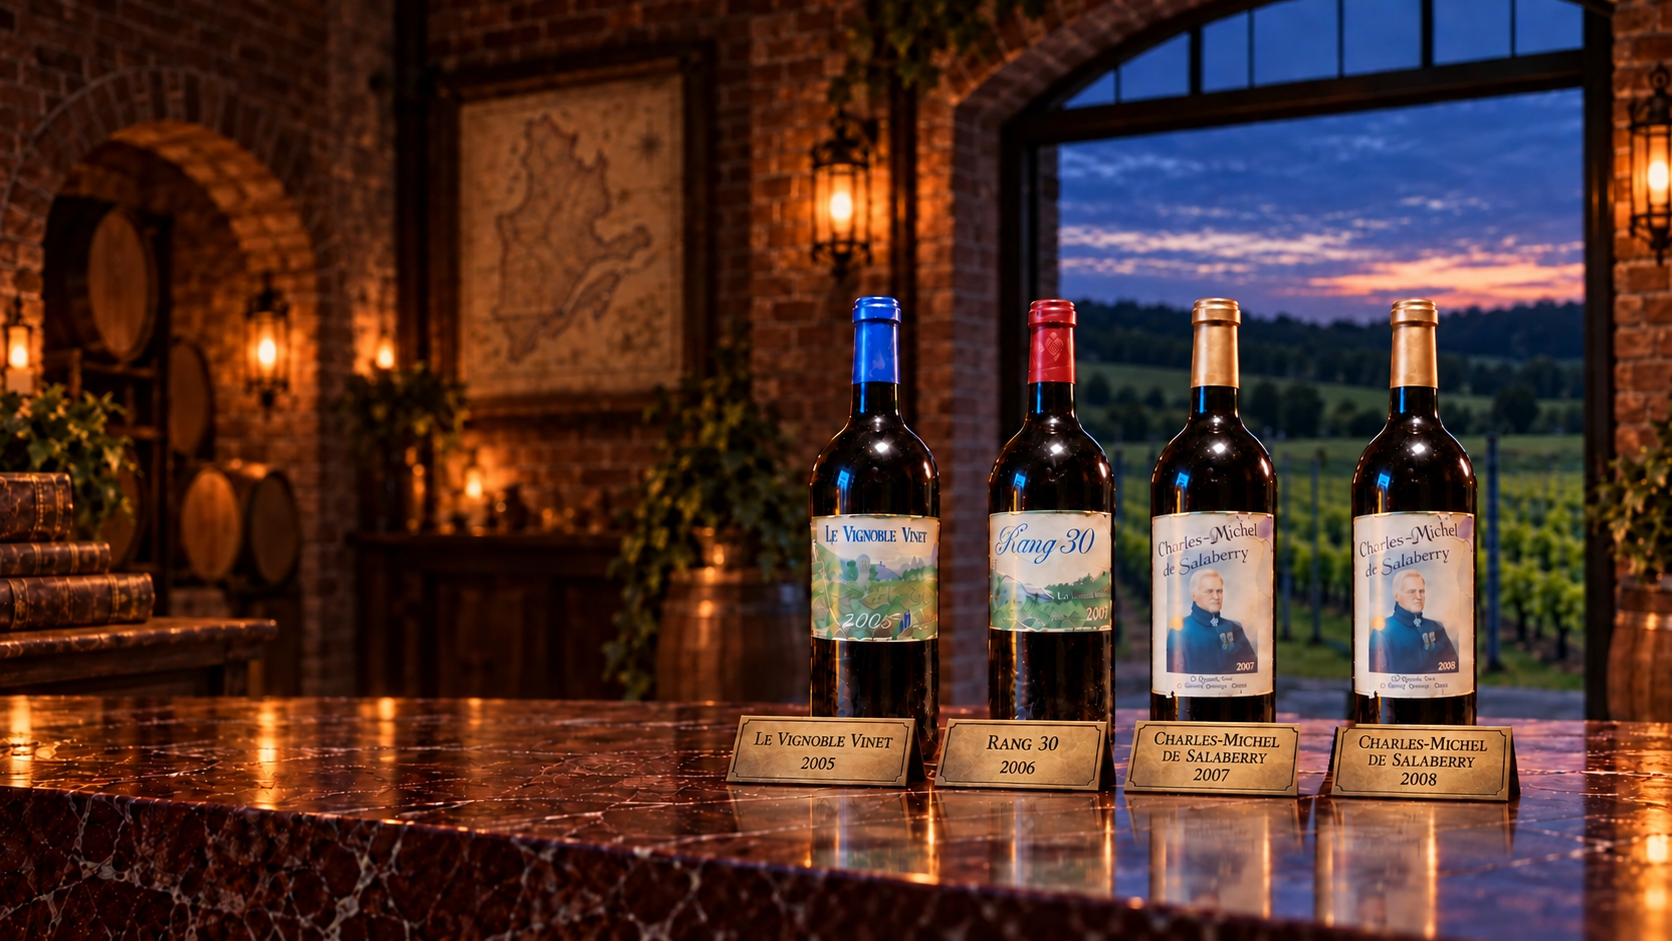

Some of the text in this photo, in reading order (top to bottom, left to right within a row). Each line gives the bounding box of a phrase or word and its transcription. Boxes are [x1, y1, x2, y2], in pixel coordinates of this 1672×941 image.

[825, 525, 927, 545] LE VIGNOBLE VINET
[1060, 528, 1095, 554] 30
[1158, 522, 1258, 557] Charles-Michel
[1360, 522, 1458, 557] Charles-Michel
[1163, 548, 1249, 577] de Salaberry
[1365, 549, 1450, 577] de Salaberry
[1236, 661, 1255, 671] 2007
[753, 732, 893, 749] LE VIGNOBLE VINET
[986, 734, 1059, 751] RANG 30
[1154, 731, 1280, 748] CHARLES-MICHEL
[1359, 735, 1488, 752] CHARLES-MICHEL
[800, 756, 836, 770] 2005
[1162, 749, 1267, 764] DE SALABERRY
[1368, 753, 1475, 768] DE SALABERRY
[999, 760, 1036, 774] 2006
[1193, 768, 1230, 782] 2007
[1400, 773, 1437, 786] 2008
